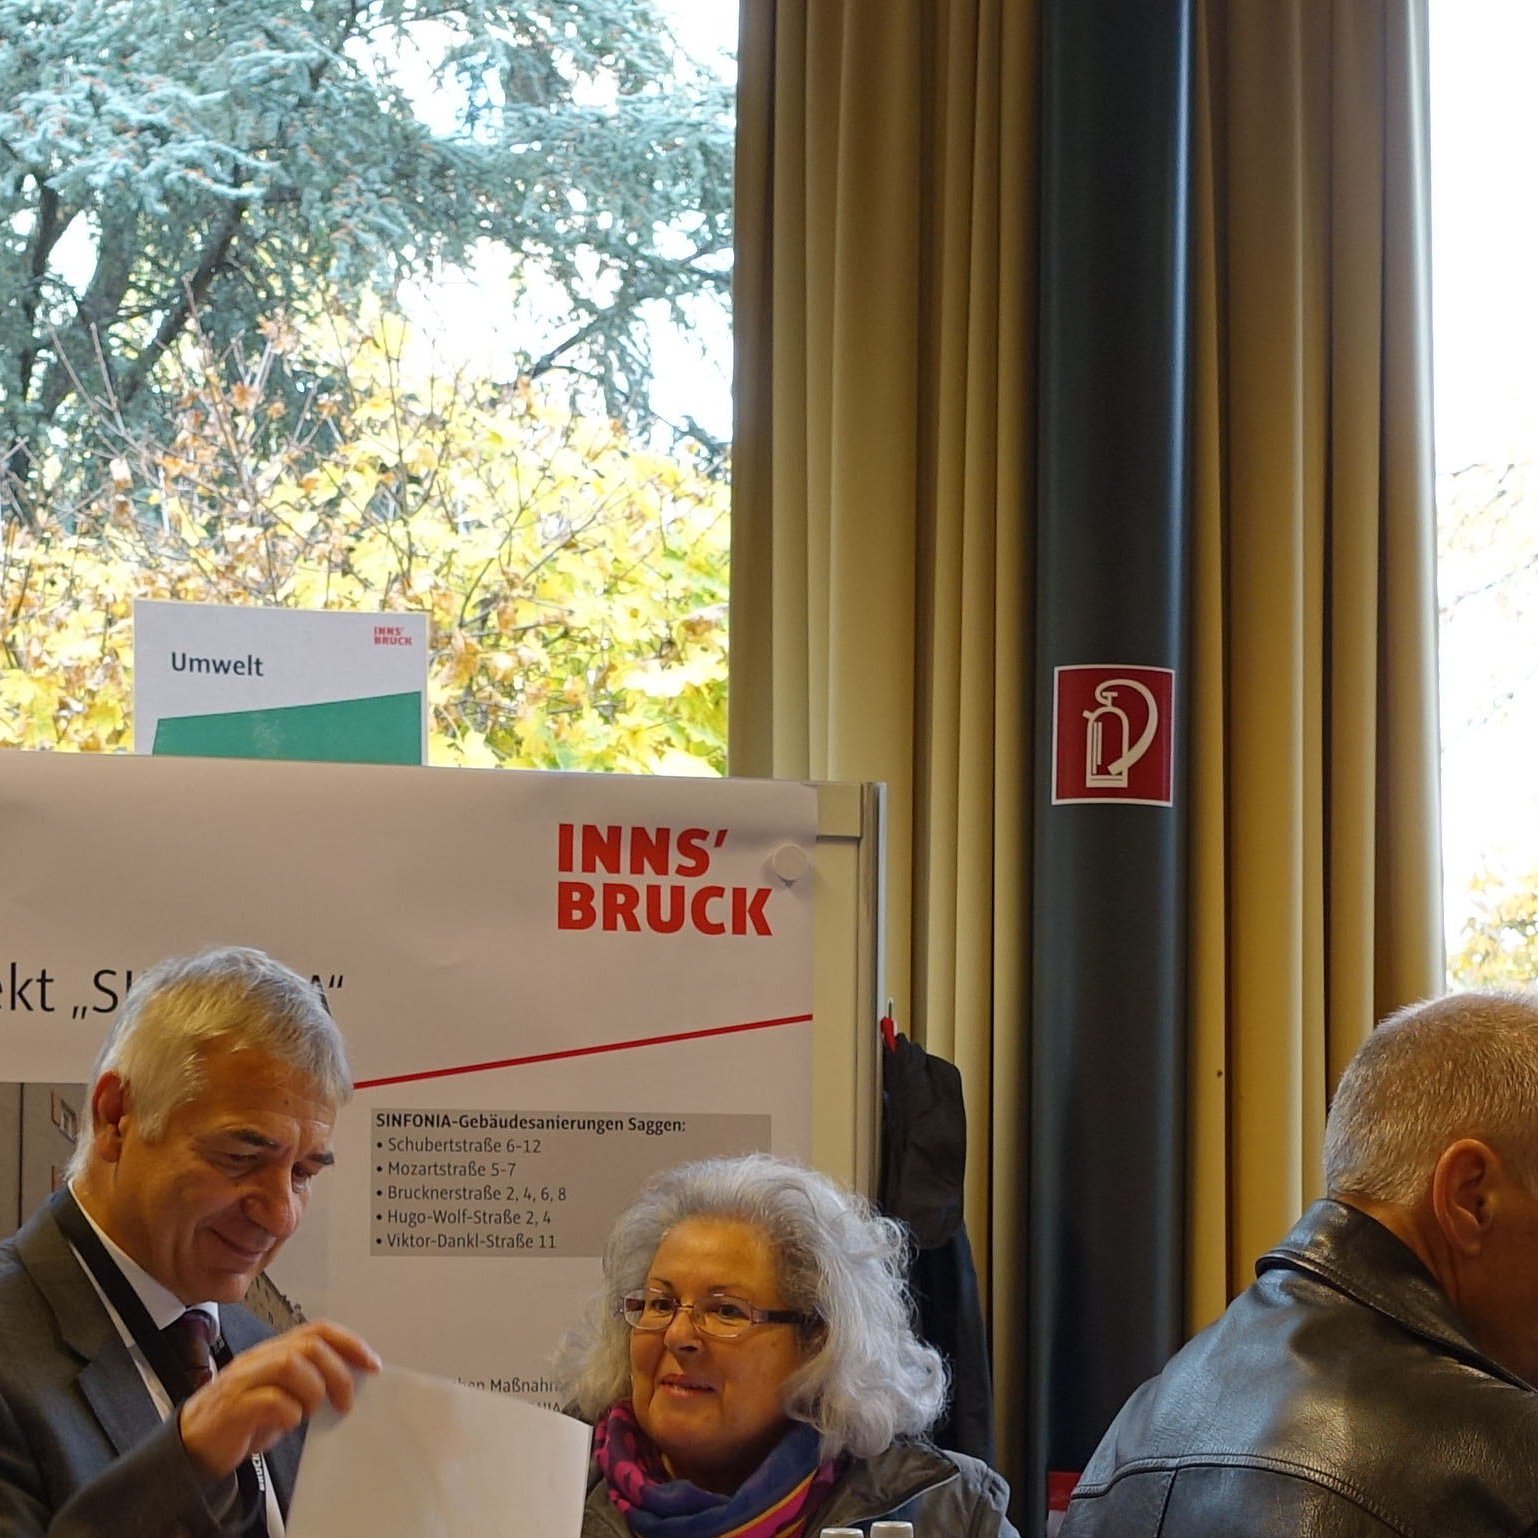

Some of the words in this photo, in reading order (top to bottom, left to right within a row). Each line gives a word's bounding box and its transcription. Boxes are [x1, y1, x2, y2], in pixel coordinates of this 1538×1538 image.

[374, 636, 413, 646] BRUCK
[171, 651, 265, 678] Umwelt
[558, 823, 728, 878] INNS'
[558, 881, 773, 936] BRUCK
[376, 1113, 624, 1134] SINFONIA-Gebäudesanierungen
[628, 1117, 687, 1135] Saggen:
[388, 1137, 502, 1153] Schubertstraße
[506, 1139, 541, 1154] 6-12
[388, 1161, 486, 1177] Mozartstraße
[491, 1162, 516, 1177] 5-7
[388, 1185, 502, 1201] Brucknerstraße
[506, 1187, 519, 1203] 2,
[523, 1187, 536, 1203] 4,
[540, 1188, 553, 1203] 6,
[558, 1187, 567, 1201] 8
[387, 1208, 521, 1228] Hugo-Wolf-Straße
[525, 1210, 539, 1227] 2,
[542, 1210, 551, 1225] 4
[387, 1232, 534, 1250] Viktor-Dankl-Straße
[538, 1234, 557, 1249] 11
